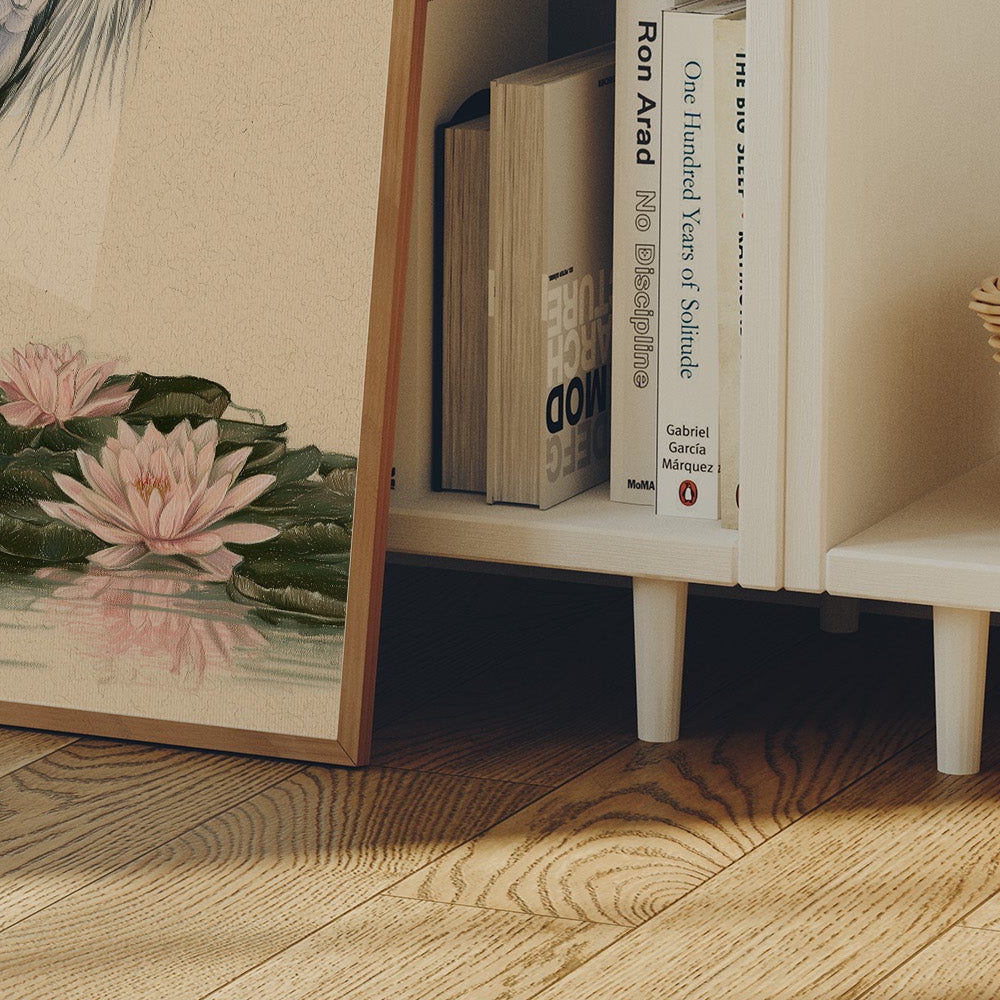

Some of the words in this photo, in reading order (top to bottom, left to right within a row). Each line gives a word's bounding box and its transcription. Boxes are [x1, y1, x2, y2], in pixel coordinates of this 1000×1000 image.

[637, 21, 657, 81] Ron
[684, 60, 702, 104] One
[636, 92, 657, 165] Arad
[682, 112, 702, 200] Hundred
[634, 190, 656, 232] No
[681, 207, 701, 261] Years
[681, 267, 700, 292] of
[630, 243, 656, 389] Discipline
[680, 298, 700, 379] Solitude
[546, 365, 608, 434] MOD
[666, 424, 709, 438] Gabriel
[668, 441, 706, 455] García
[627, 479, 655, 491] MoMA
[662, 458, 713, 473] Márquez
